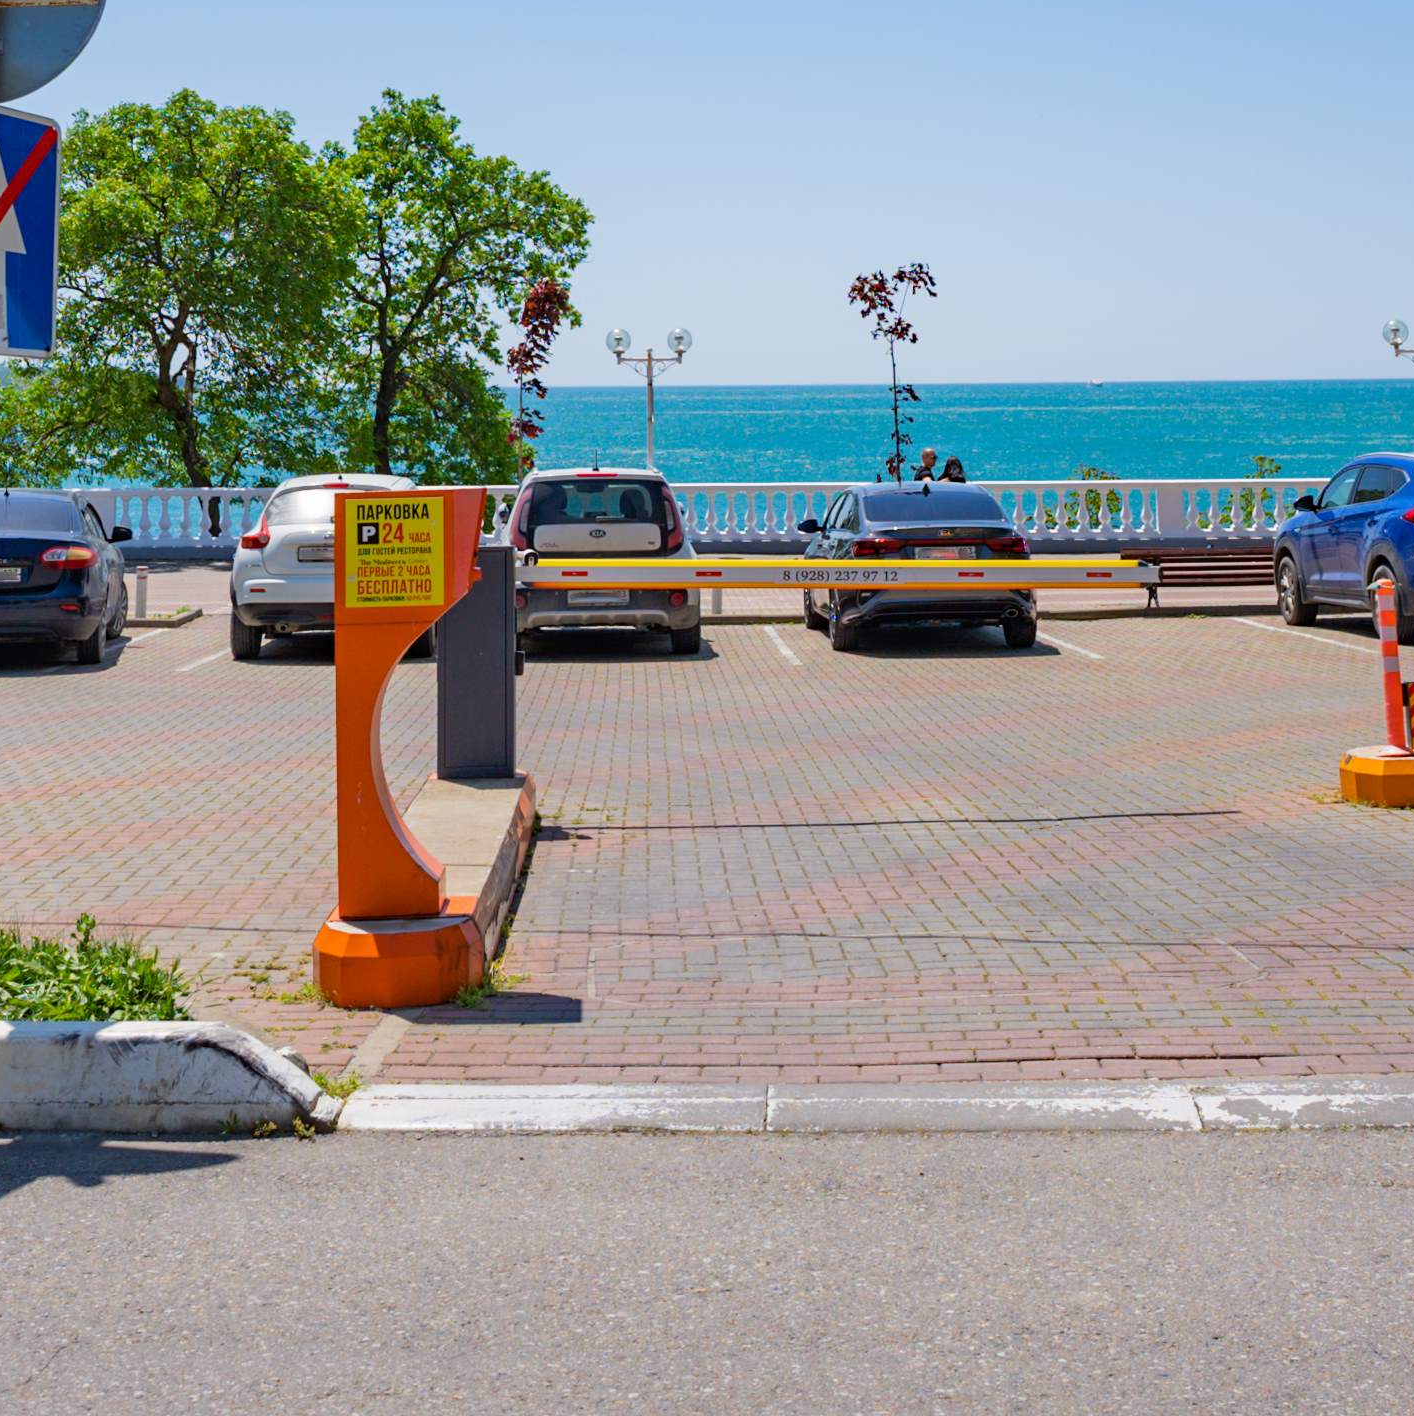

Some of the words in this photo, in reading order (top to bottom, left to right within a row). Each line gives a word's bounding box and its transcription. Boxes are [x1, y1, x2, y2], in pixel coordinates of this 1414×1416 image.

[356, 503, 430, 521] ПАРКОВКА
[361, 525, 377, 543] P
[382, 522, 405, 544] 24
[409, 532, 431, 543] ЧАСА
[357, 566, 396, 577] ПЕРВЫЕ
[398, 566, 404, 577] 2
[406, 565, 431, 576] ЧАСА
[782, 570, 791, 581] 8
[795, 570, 830, 582] (928)
[835, 570, 858, 581] 237
[862, 570, 879, 581] 97
[884, 570, 898, 581] 12
[357, 578, 432, 595] БЕСПЛАТНО
